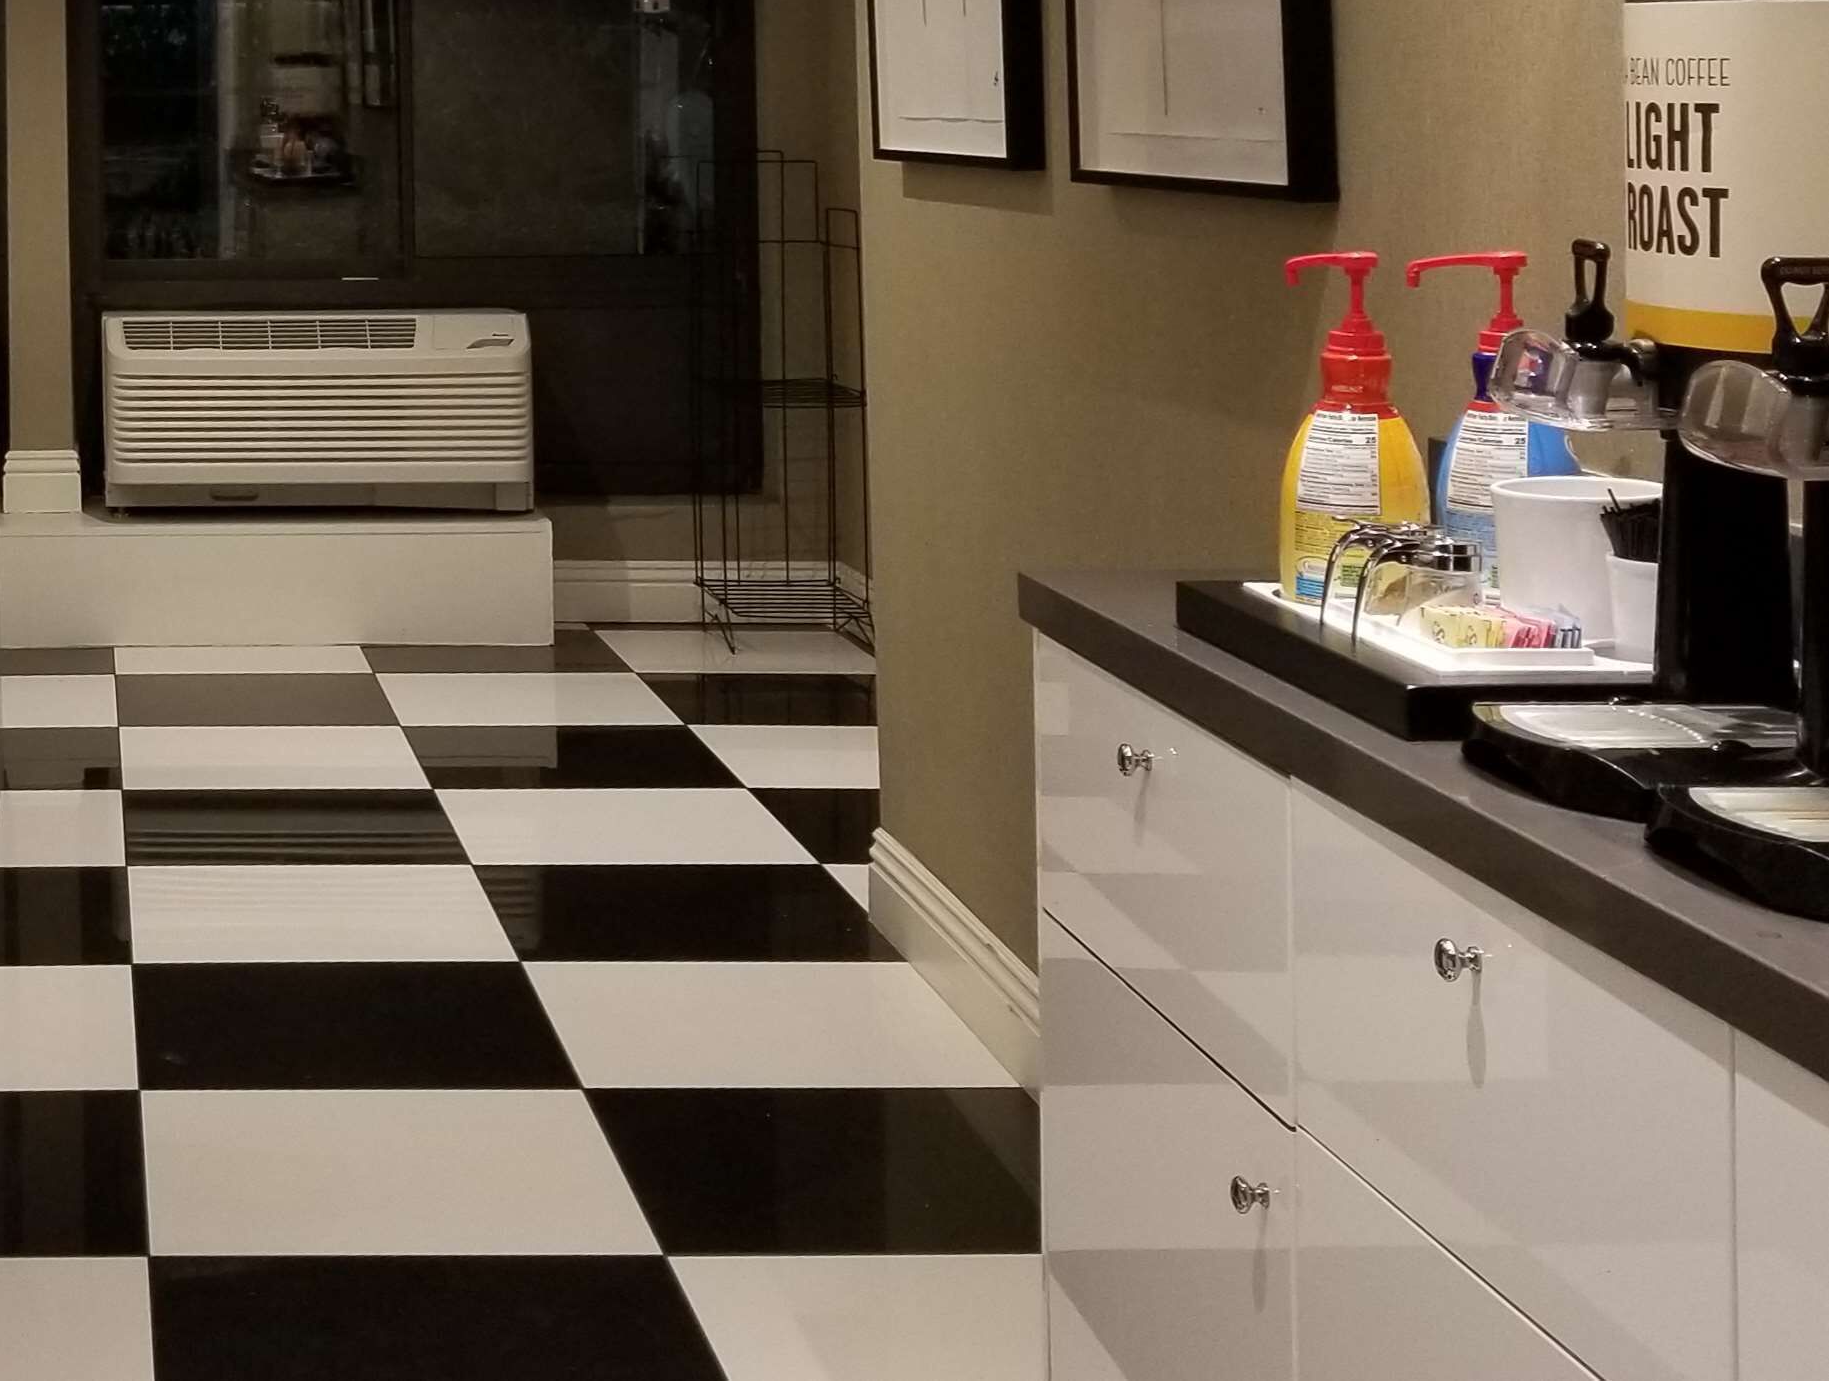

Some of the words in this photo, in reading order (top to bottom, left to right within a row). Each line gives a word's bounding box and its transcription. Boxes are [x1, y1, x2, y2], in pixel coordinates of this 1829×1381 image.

[1629, 57, 1659, 86] BEAN
[1666, 57, 1731, 87] COFFEE
[1626, 101, 1720, 173] LIGHT
[1627, 181, 1729, 258] ROAST
